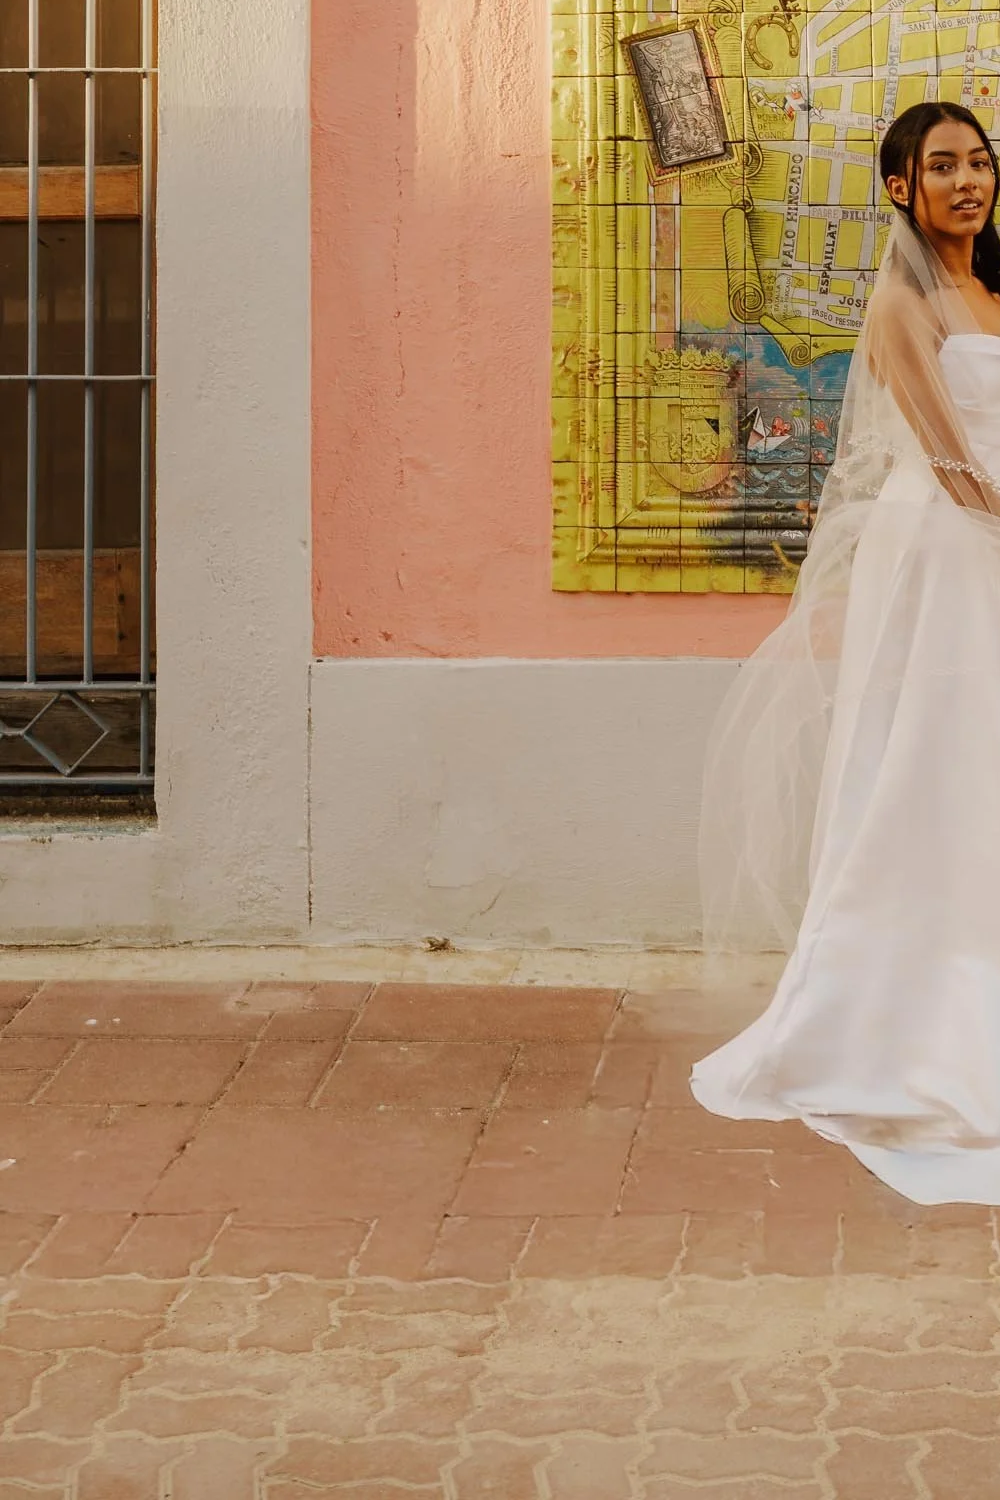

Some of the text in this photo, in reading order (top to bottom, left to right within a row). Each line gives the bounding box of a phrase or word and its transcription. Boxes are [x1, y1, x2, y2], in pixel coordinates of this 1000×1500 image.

[907, 19, 953, 32] SANTIAGO
[963, 44, 977, 95] REYES
[781, 153, 803, 268] PALO HINCADO
[820, 221, 838, 295] ESPAILLAT
[811, 308, 864, 327] PASEO PRESIDEN
[839, 296, 868, 309] JOSE
